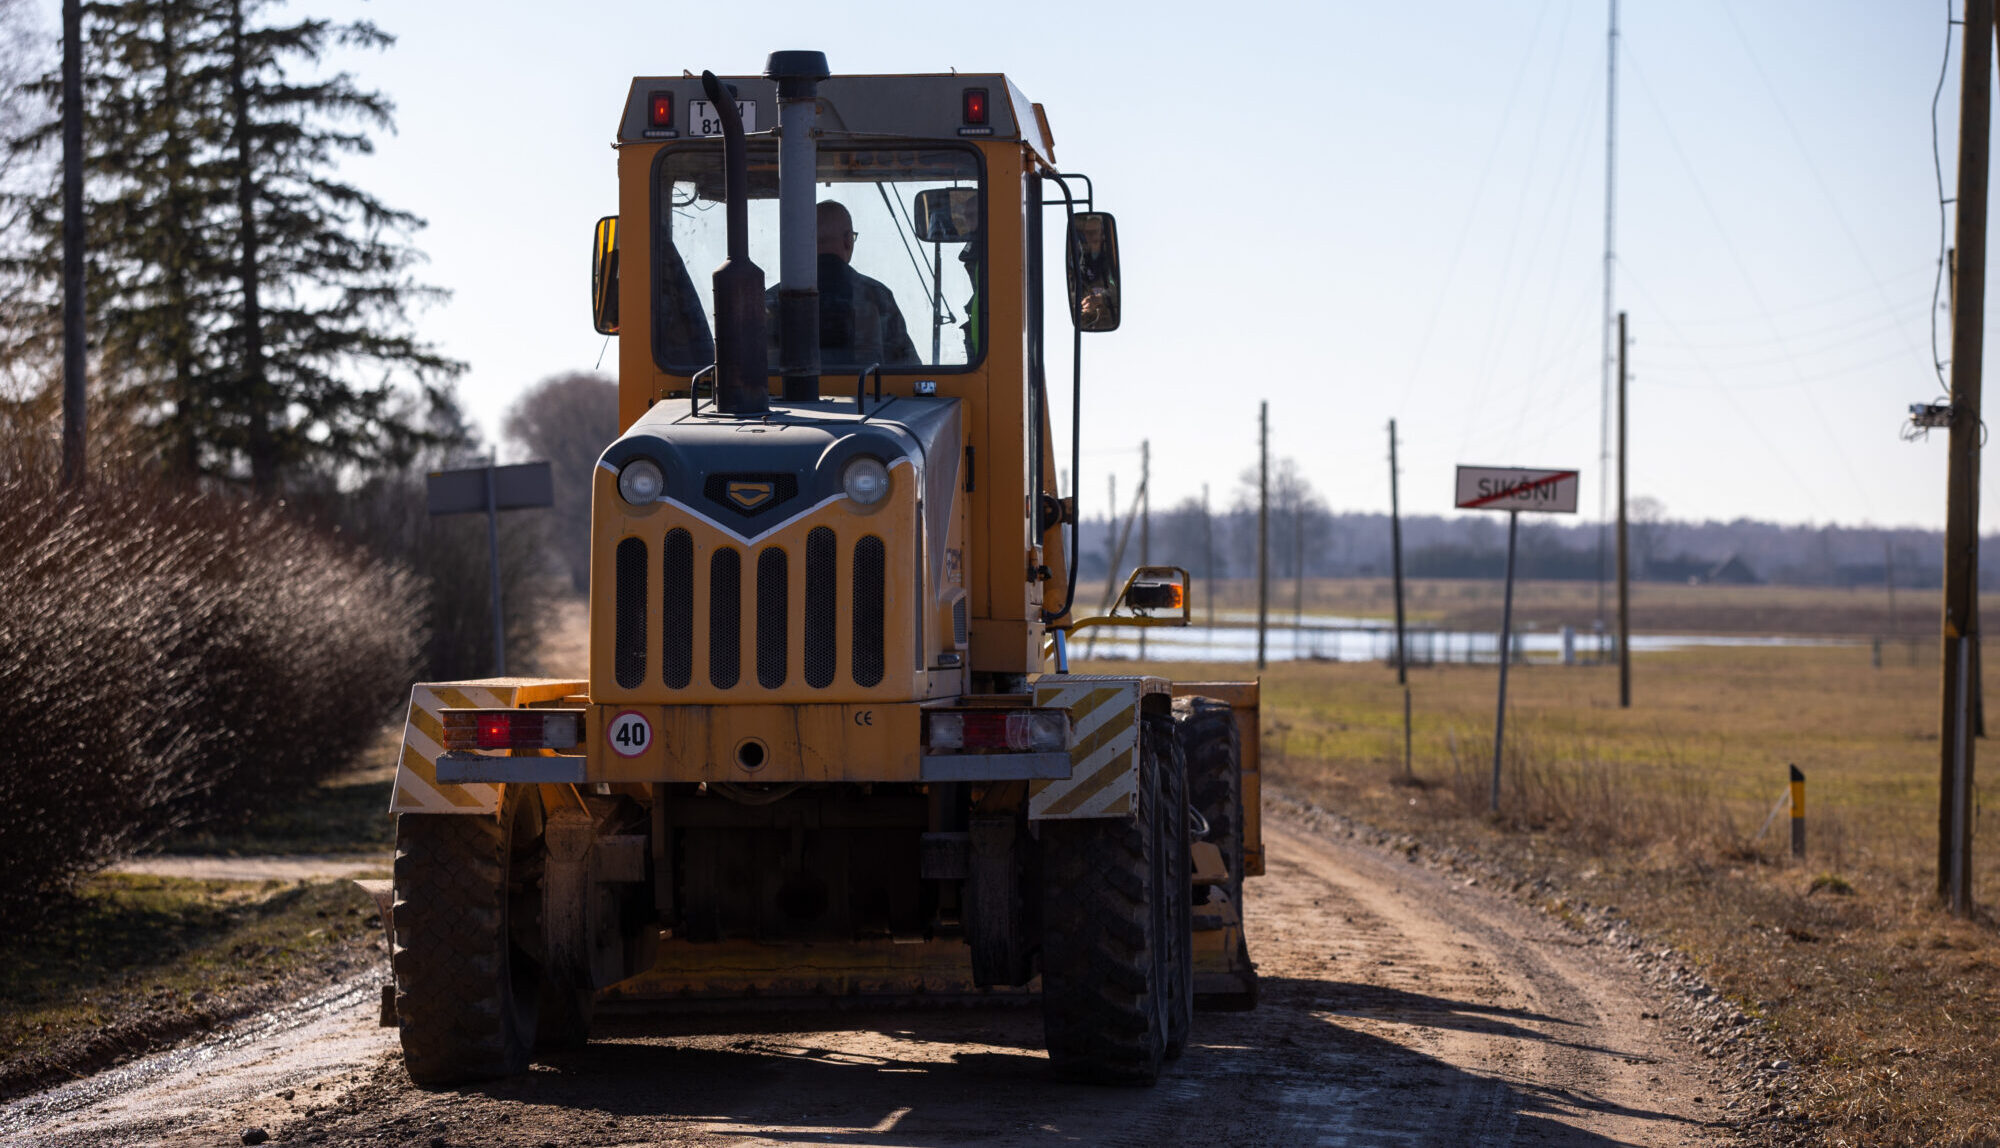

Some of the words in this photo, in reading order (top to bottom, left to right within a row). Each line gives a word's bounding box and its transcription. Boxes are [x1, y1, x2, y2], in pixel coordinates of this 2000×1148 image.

[697, 102, 706, 117] T
[702, 119, 722, 134] 81
[855, 711, 872, 726] CE
[616, 722, 645, 746] 40
